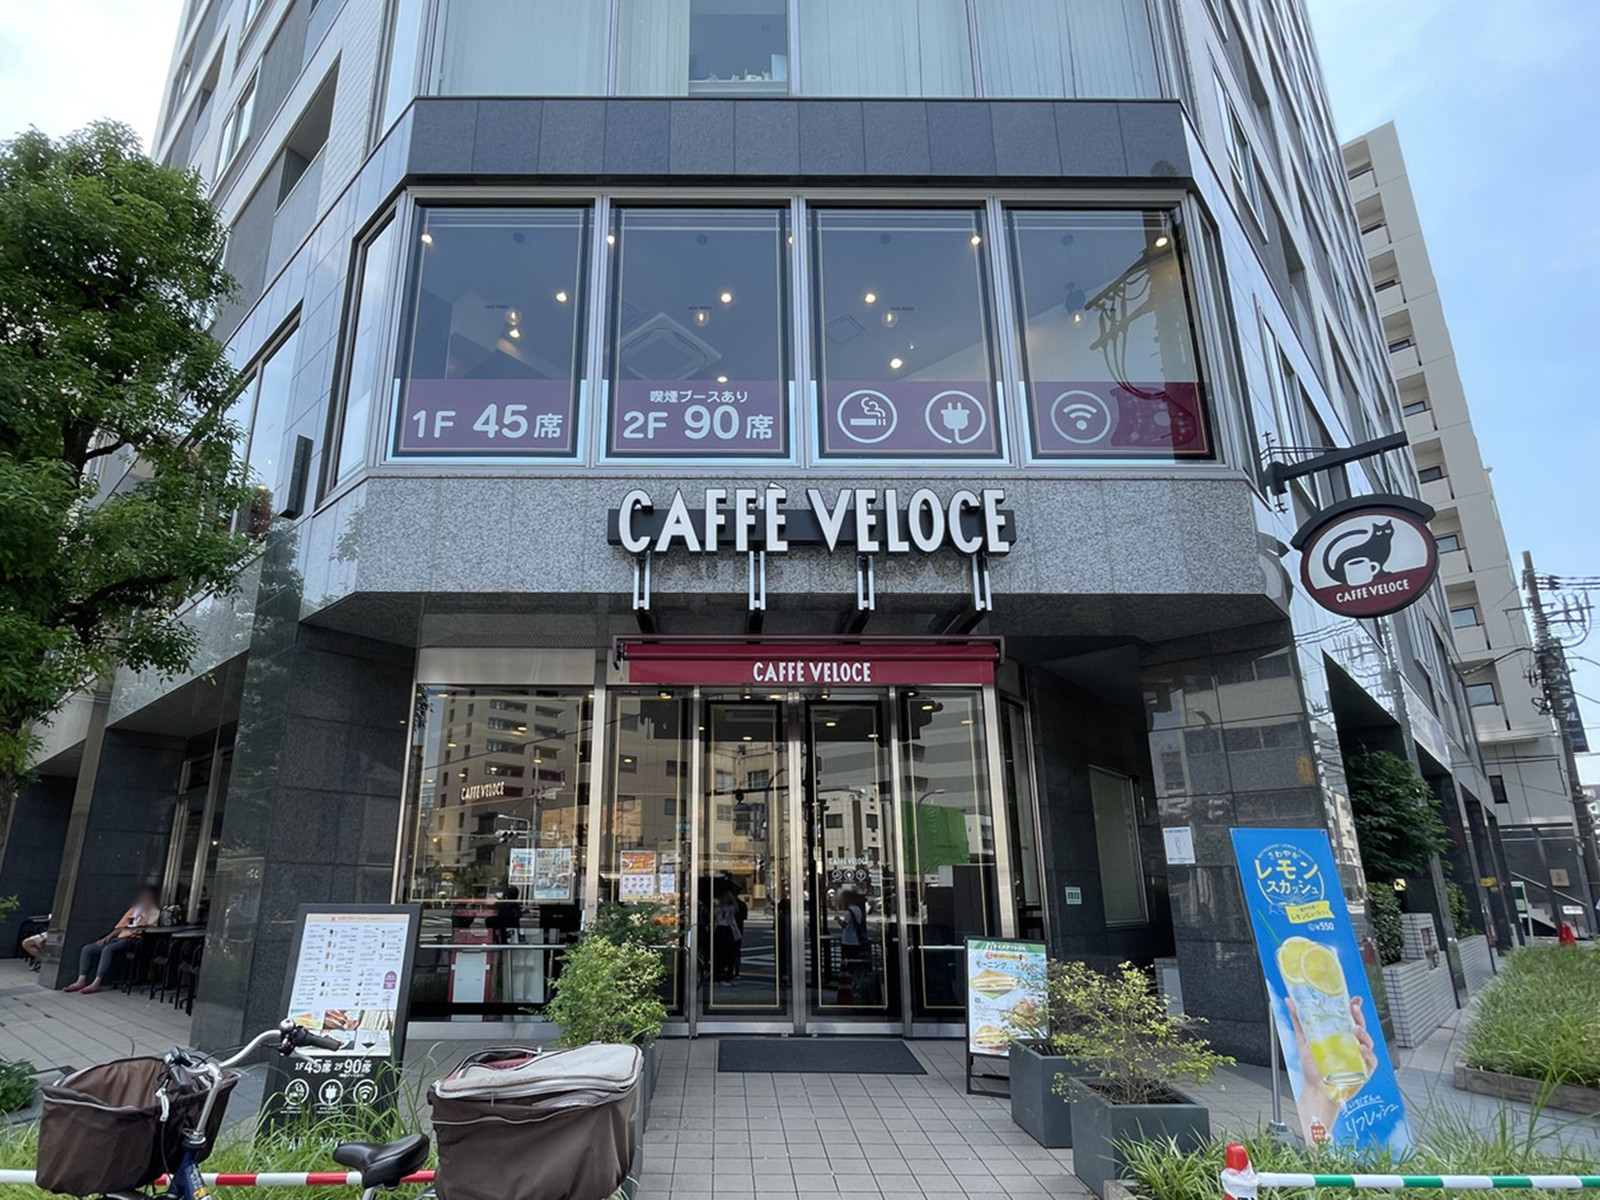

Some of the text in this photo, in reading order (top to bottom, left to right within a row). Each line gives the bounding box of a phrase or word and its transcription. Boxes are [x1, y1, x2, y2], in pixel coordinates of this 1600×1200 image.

[649, 390, 748, 404] 喫煙ブースあり
[412, 410, 456, 438] 1F
[623, 411, 668, 439] 2F
[806, 487, 1012, 553] VELOCE
[1369, 578, 1410, 596] VELOCE
[809, 662, 871, 682] VELOCE
[1254, 859, 1319, 880] レモン
[1266, 879, 1320, 895] スカッシュ
[1345, 1103, 1399, 1141] リフレッシュ
